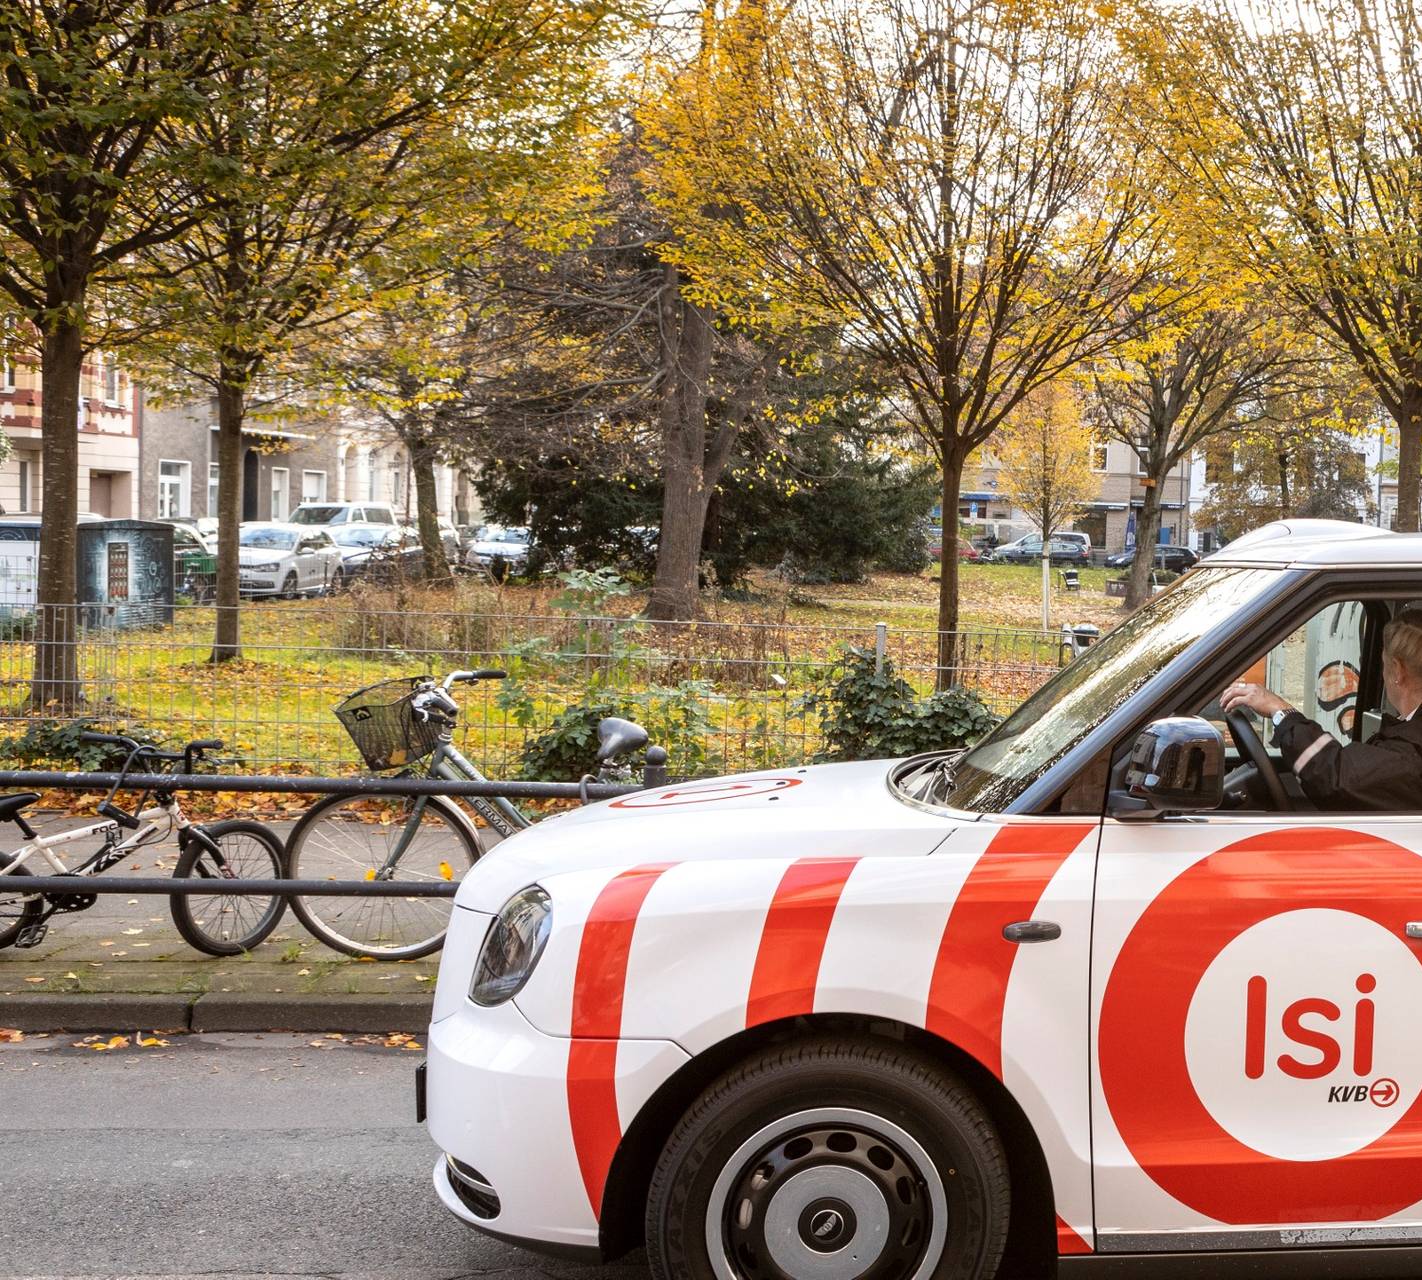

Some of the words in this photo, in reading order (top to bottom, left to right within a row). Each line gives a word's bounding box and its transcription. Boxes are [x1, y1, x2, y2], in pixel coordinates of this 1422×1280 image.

[92, 823, 119, 835] FOC
[1244, 973, 1376, 1079] Isi
[1328, 1085, 1368, 1103] KVB
